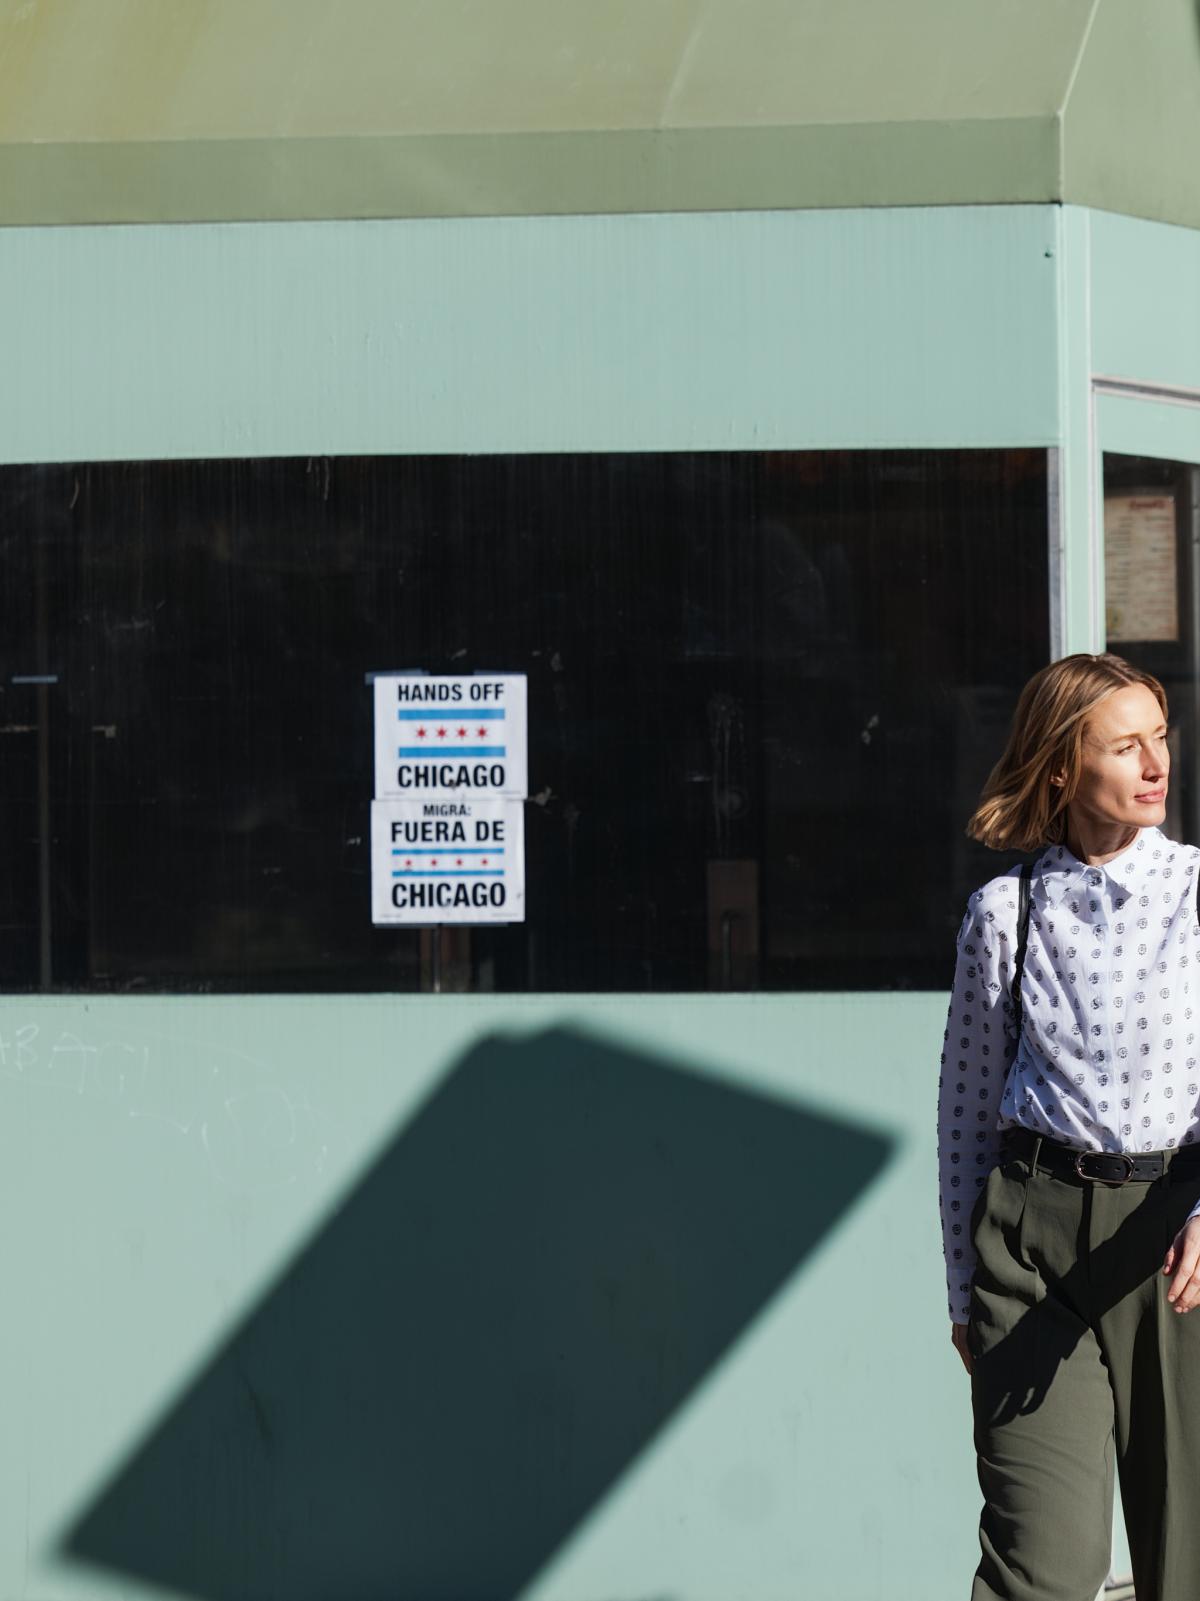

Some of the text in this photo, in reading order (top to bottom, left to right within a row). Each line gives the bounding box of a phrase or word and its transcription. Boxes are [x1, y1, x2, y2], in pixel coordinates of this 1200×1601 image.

[397, 683, 504, 701] HANDS OFF
[397, 764, 506, 788] CHICAGO
[423, 804, 471, 816] MIGRA:
[391, 820, 505, 842] FUERA DE
[391, 882, 506, 909] CHICAGO
